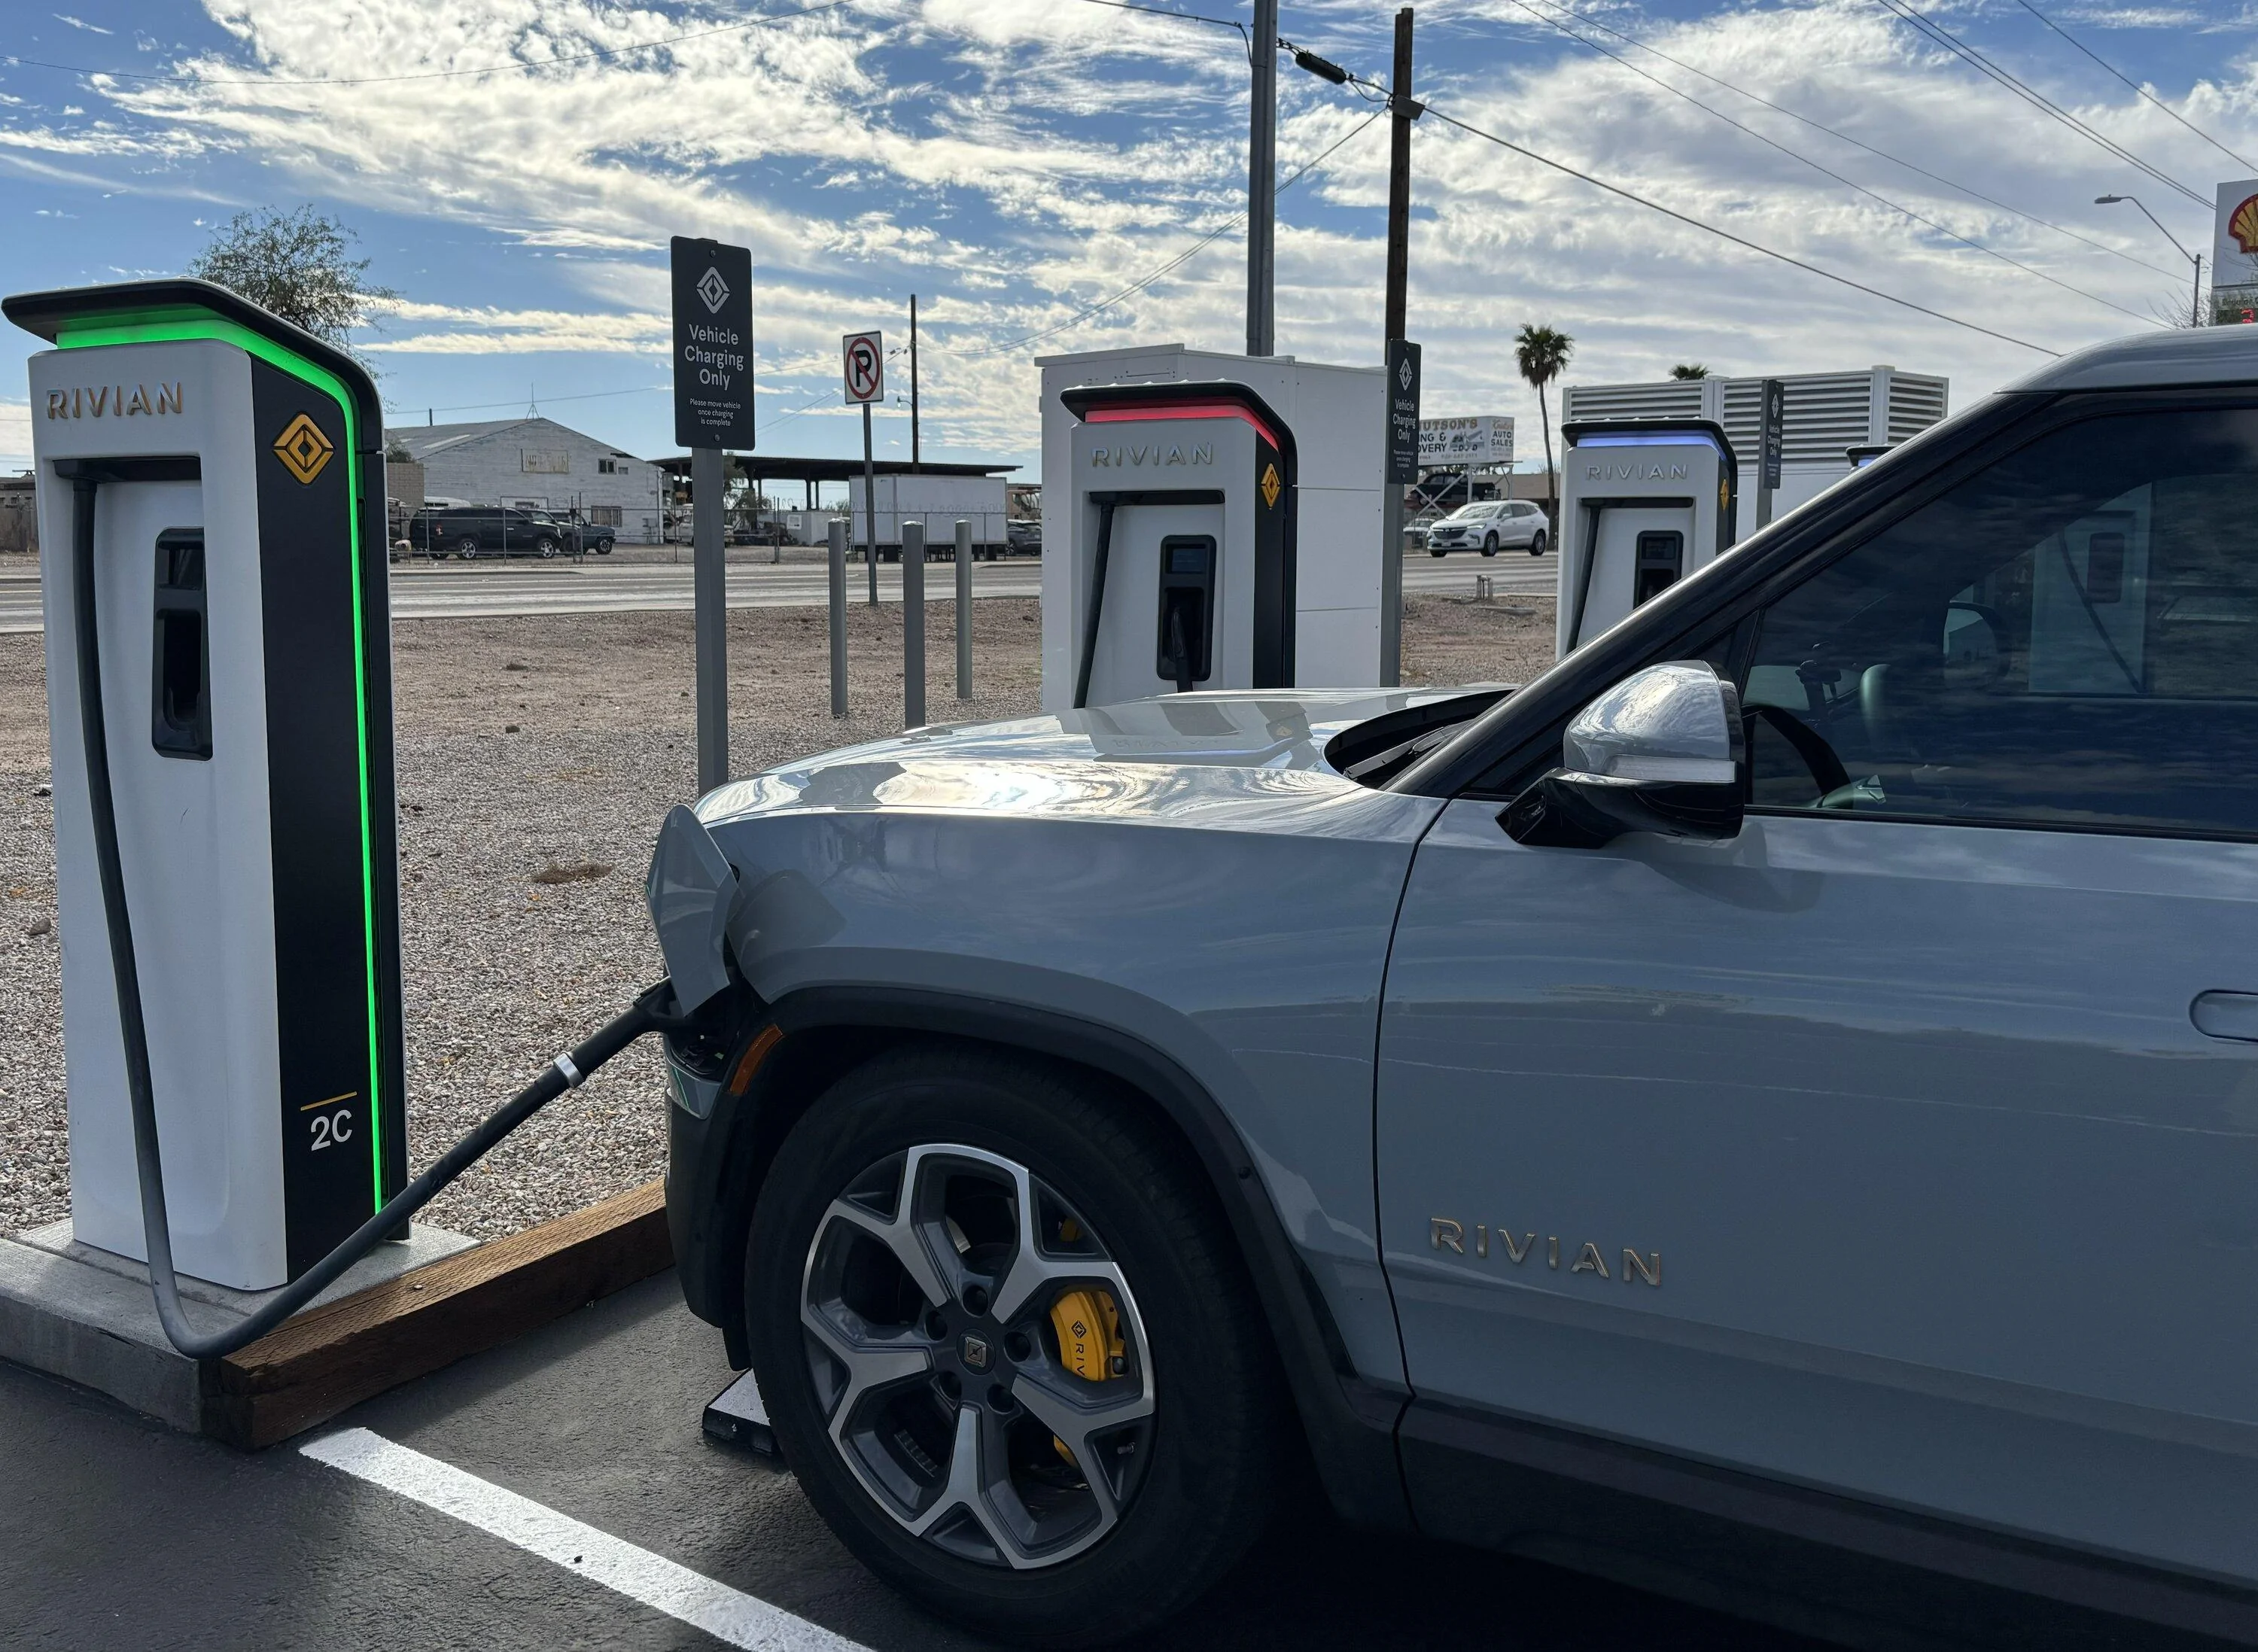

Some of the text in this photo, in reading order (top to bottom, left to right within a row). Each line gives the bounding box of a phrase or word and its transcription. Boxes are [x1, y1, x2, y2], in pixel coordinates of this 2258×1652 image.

[688, 324, 738, 345] Vehicle
[684, 345, 744, 371] Charging
[698, 369, 731, 391] Only
[47, 382, 182, 419] RIVIAN
[689, 398, 707, 406] Please
[723, 401, 741, 409] vehicle
[1395, 399, 1415, 412] Vehicle
[712, 409, 734, 419] charging
[1392, 413, 1417, 429] Charging
[706, 418, 731, 427] complete
[1398, 429, 1410, 443] Only
[1418, 433, 1435, 443] NG
[1493, 430, 1512, 439] AUTO
[1490, 439, 1513, 447] SALES
[1091, 442, 1213, 467] RIVIAN
[1586, 464, 1687, 480] RIVIAN
[310, 1109, 352, 1152] 2C
[1429, 1217, 1660, 1286] RIVIAN
